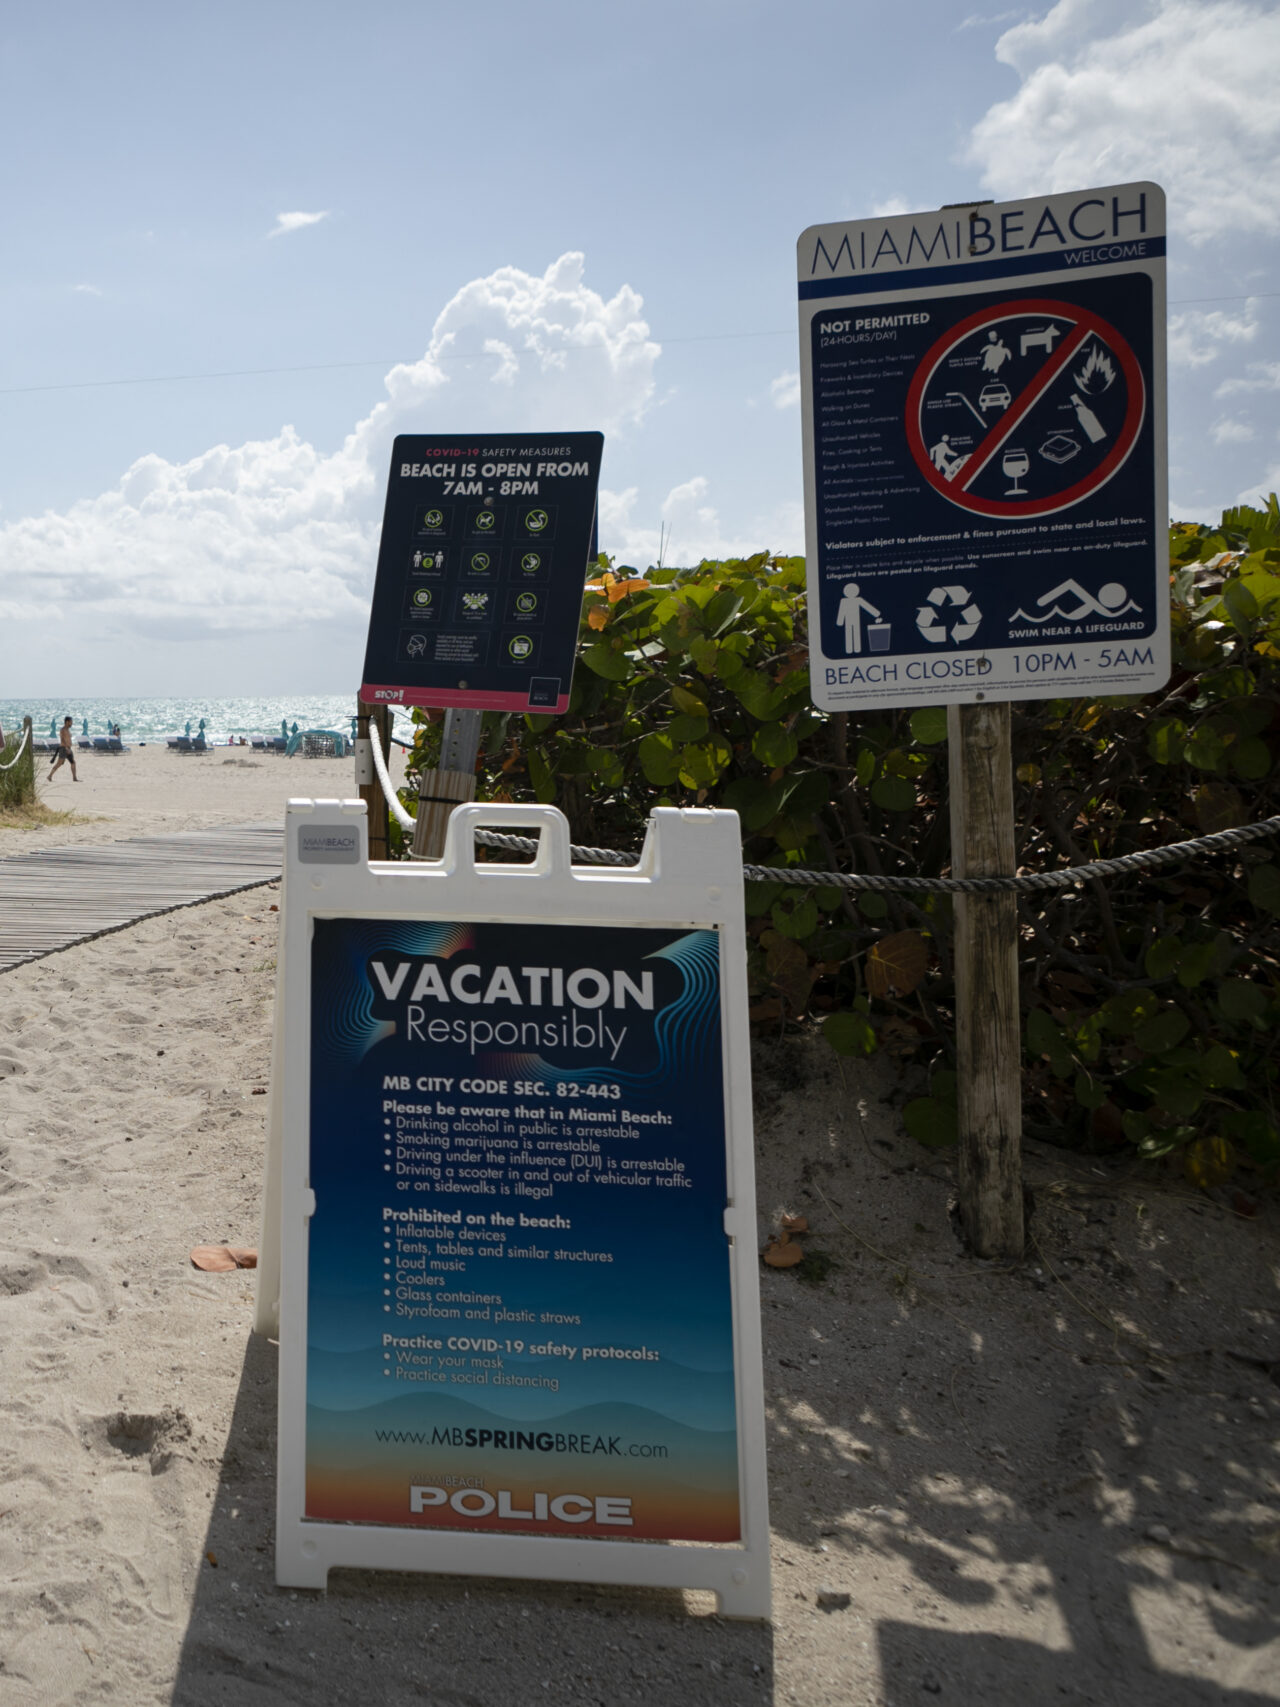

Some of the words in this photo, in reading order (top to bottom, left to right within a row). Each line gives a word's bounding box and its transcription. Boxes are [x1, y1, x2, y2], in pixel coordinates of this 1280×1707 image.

[811, 193, 1145, 274] MIAMIBEACH
[1063, 243, 1146, 264] WELCOME
[820, 320, 851, 334] NOT
[854, 312, 930, 330] PERMITTED
[820, 329, 896, 347] (24-HOURS/DAY)
[425, 448, 479, 456] COVID-19
[481, 447, 516, 456] SAFETY
[518, 447, 571, 456] MEASURES
[400, 463, 455, 477] BEACH
[460, 463, 476, 477] IS
[480, 462, 531, 477] OPEN
[536, 462, 588, 476] FROM
[442, 481, 482, 495] 7AM
[499, 481, 538, 495] 8PM
[1008, 628, 1038, 638] SWIM
[1041, 626, 1071, 636] NEAR
[1073, 625, 1082, 634] A
[1085, 621, 1145, 633] LIFEGUARD
[825, 663, 897, 685] BEACH
[905, 657, 993, 679] CLOSED
[1013, 651, 1076, 673] 10PM
[1097, 646, 1154, 668] 5AM
[374, 689, 404, 701] STOP!
[303, 838, 355, 847] MIAMIBEACH
[371, 961, 654, 1010] VACATION
[407, 1004, 627, 1060] Responsibly
[382, 1075, 411, 1090] MB
[416, 1076, 454, 1092] CITY
[459, 1078, 508, 1094] CODE
[513, 1080, 550, 1096] SEC.
[556, 1082, 620, 1099] 82-443
[382, 1100, 432, 1117] Please
[436, 1102, 455, 1115] be
[459, 1106, 510, 1117] aware
[513, 1104, 545, 1119] that
[549, 1106, 564, 1120] in
[568, 1107, 616, 1122] Miami
[621, 1109, 672, 1124] Beach:
[395, 1116, 448, 1134] Drinking
[452, 1118, 499, 1132] alcohol
[503, 1120, 515, 1133] in
[519, 1121, 558, 1137] public
[561, 1123, 572, 1135] is
[575, 1124, 640, 1140] arrestable
[395, 1132, 450, 1149] Smoking
[454, 1135, 518, 1151] marijuana
[521, 1137, 533, 1150] is
[536, 1139, 600, 1153] arrestable
[395, 1146, 441, 1164] Driving
[445, 1149, 482, 1162] under
[485, 1150, 505, 1164] the
[509, 1151, 566, 1166] influence
[570, 1153, 602, 1170] (DUI)
[606, 1155, 617, 1168] is
[620, 1157, 685, 1171] arrestable
[395, 1162, 441, 1180] Driving
[445, 1168, 454, 1178] a
[458, 1168, 503, 1180] scooter
[508, 1168, 520, 1180] in
[524, 1169, 549, 1181] and
[553, 1170, 573, 1182] out
[576, 1169, 590, 1183] of
[592, 1170, 652, 1185] vehicular
[655, 1172, 692, 1187] traffic
[396, 1180, 410, 1190] or
[413, 1181, 430, 1191] on
[434, 1180, 496, 1194] sidewalks
[500, 1182, 510, 1195] is
[514, 1182, 553, 1199] illegal
[382, 1207, 461, 1223] Prohibited
[465, 1214, 485, 1225] on
[489, 1212, 515, 1226] the
[519, 1213, 570, 1229] beach:
[395, 1224, 454, 1239] Inflatable
[458, 1226, 506, 1241] devices
[395, 1239, 431, 1256] Tents,
[435, 1242, 474, 1257] tables
[477, 1244, 503, 1257] and
[506, 1245, 550, 1259] similar
[553, 1248, 613, 1262] structures
[395, 1256, 425, 1269] Loud
[430, 1258, 465, 1271] music
[395, 1272, 445, 1285] Coolers
[395, 1287, 432, 1301] Glass
[435, 1291, 502, 1304] containers
[395, 1304, 461, 1321] Styrofoam
[464, 1307, 490, 1321] and
[494, 1308, 536, 1326] plastic
[539, 1311, 581, 1325] straws
[382, 1333, 442, 1349] Practice
[447, 1336, 525, 1353] COVID-19
[529, 1341, 577, 1358] safety
[582, 1344, 660, 1361] protocols:
[395, 1351, 434, 1365] Wear
[438, 1355, 467, 1369] your
[471, 1355, 504, 1369] mask
[395, 1368, 447, 1383] Practice
[451, 1371, 489, 1385] social
[492, 1372, 560, 1391] distancing
[375, 1428, 668, 1458] www.MBSPRINGBREAK.com
[410, 1485, 634, 1525] POLICE
